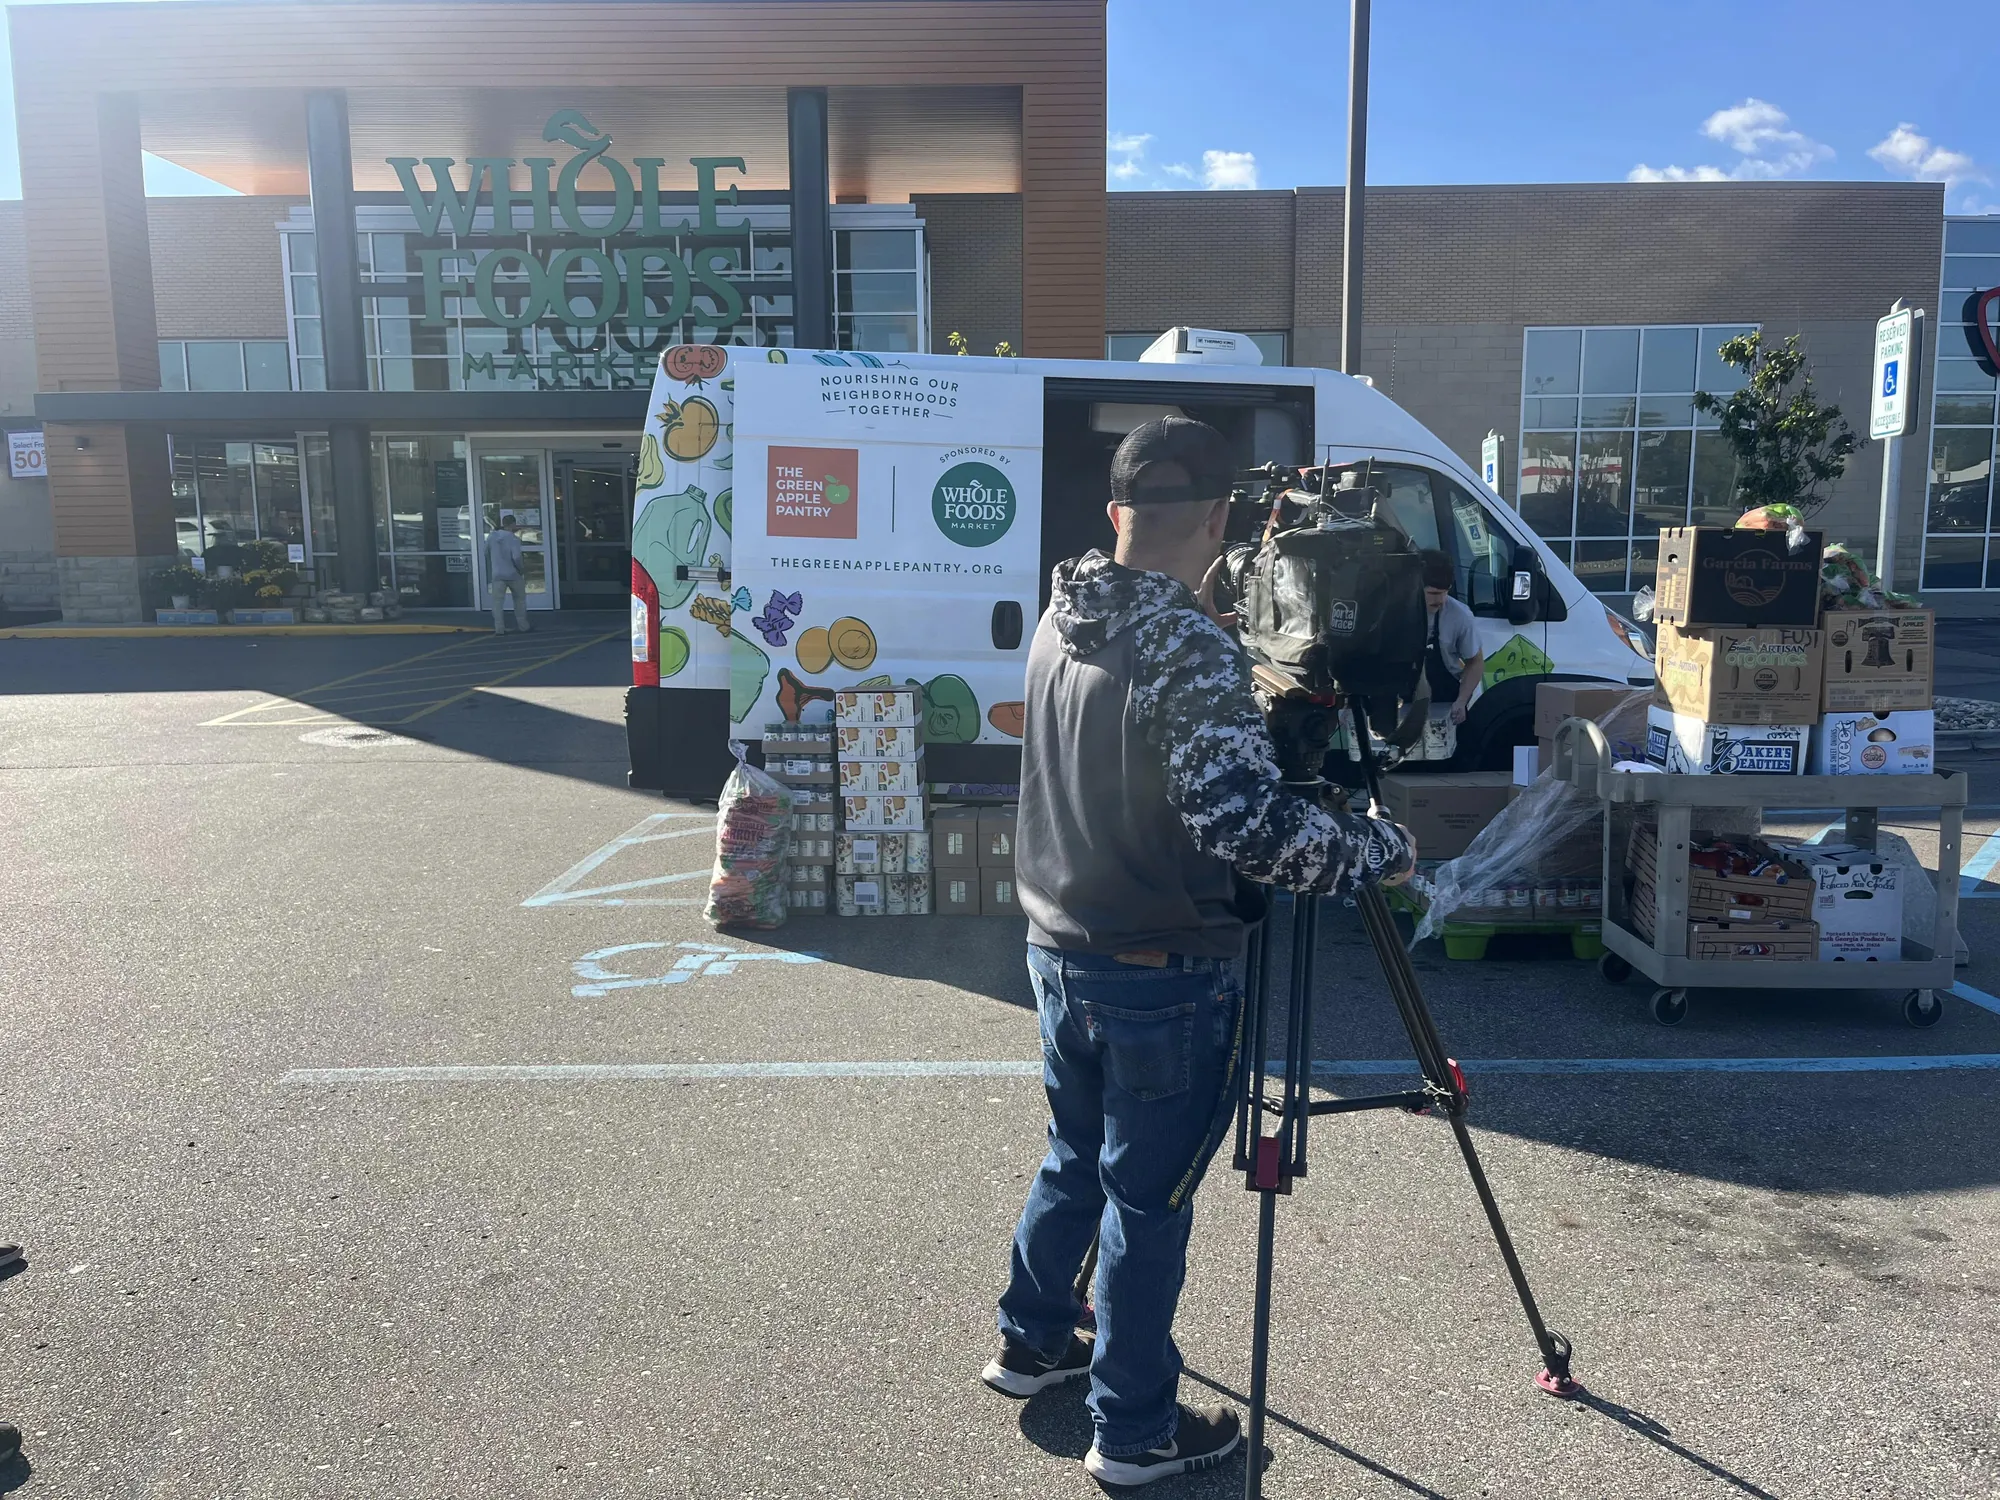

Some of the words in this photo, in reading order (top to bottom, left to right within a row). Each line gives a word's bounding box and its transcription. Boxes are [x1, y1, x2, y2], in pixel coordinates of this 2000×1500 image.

[386, 140, 750, 238] WHOLE
[415, 247, 744, 328] FOODS
[1879, 322, 1906, 344] RESERVED
[1880, 341, 1903, 360] PARKING
[463, 351, 660, 381] MARKE
[820, 374, 919, 386] NOURISHING
[929, 378, 959, 392] OUR
[821, 389, 957, 407] NEIGHBORHOODS
[848, 405, 930, 418] TOGETHER
[939, 446, 996, 464] SPONSORED
[999, 455, 1011, 465] BY
[775, 466, 804, 478] THE
[775, 479, 823, 492] GREEN
[940, 484, 1008, 504] WHOLE
[775, 492, 821, 504] APPLE
[775, 505, 832, 518] PANTRY
[944, 503, 1006, 521] FOODS
[951, 522, 996, 530] MARKET
[770, 557, 1003, 575] THEGREENAPPLEPANTRY.ORG
[1703, 557, 1756, 570] Garcia
[1761, 558, 1813, 571] Farms
[1758, 643, 1806, 653] ARTISAN
[1725, 652, 1808, 669] organics
